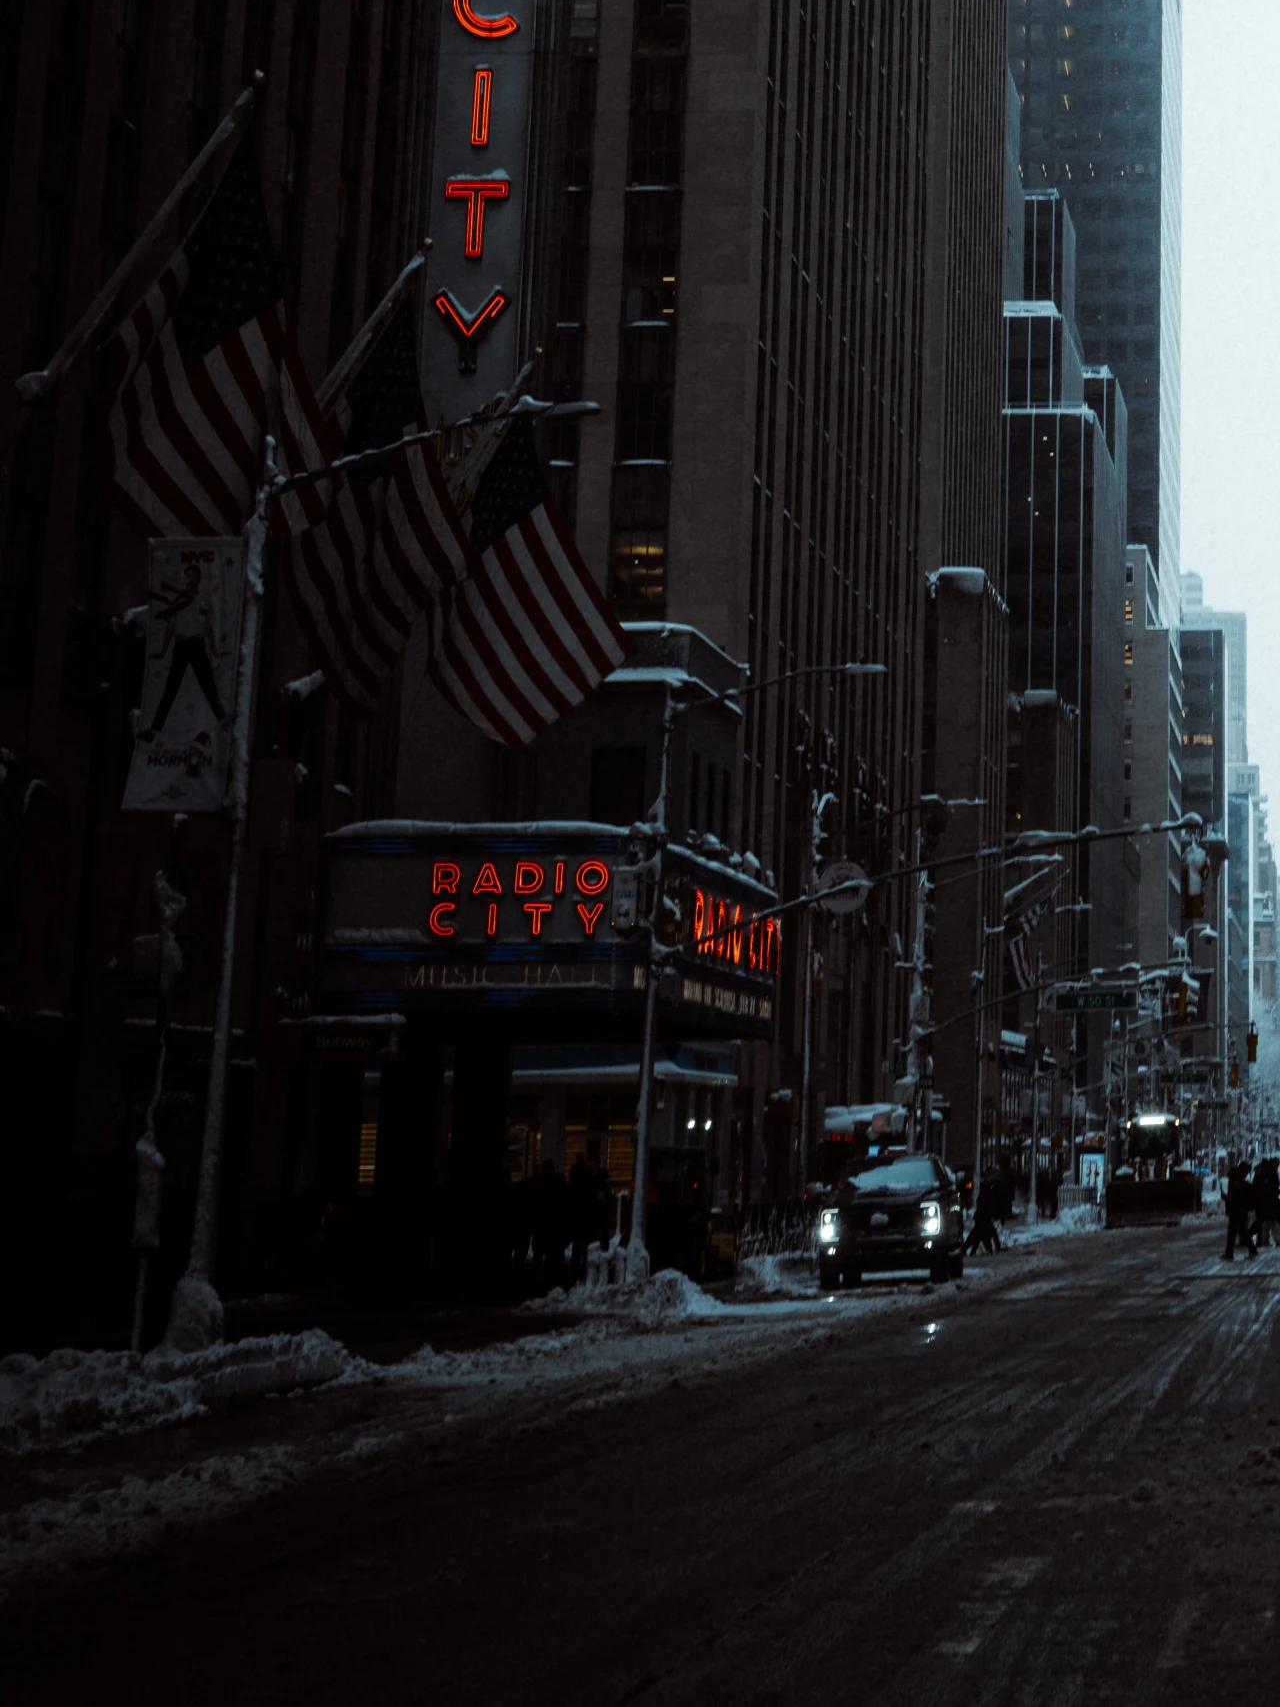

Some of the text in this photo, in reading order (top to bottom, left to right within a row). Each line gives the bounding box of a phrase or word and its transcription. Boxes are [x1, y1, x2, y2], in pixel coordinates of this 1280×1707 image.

[431, 860, 610, 896] RADIO
[428, 902, 606, 936] CITY
[692, 887, 744, 965] RADIO
[404, 964, 494, 989] MUSIC
[1077, 993, 1116, 1007] W 50 St
[315, 1034, 375, 1050] Subway
